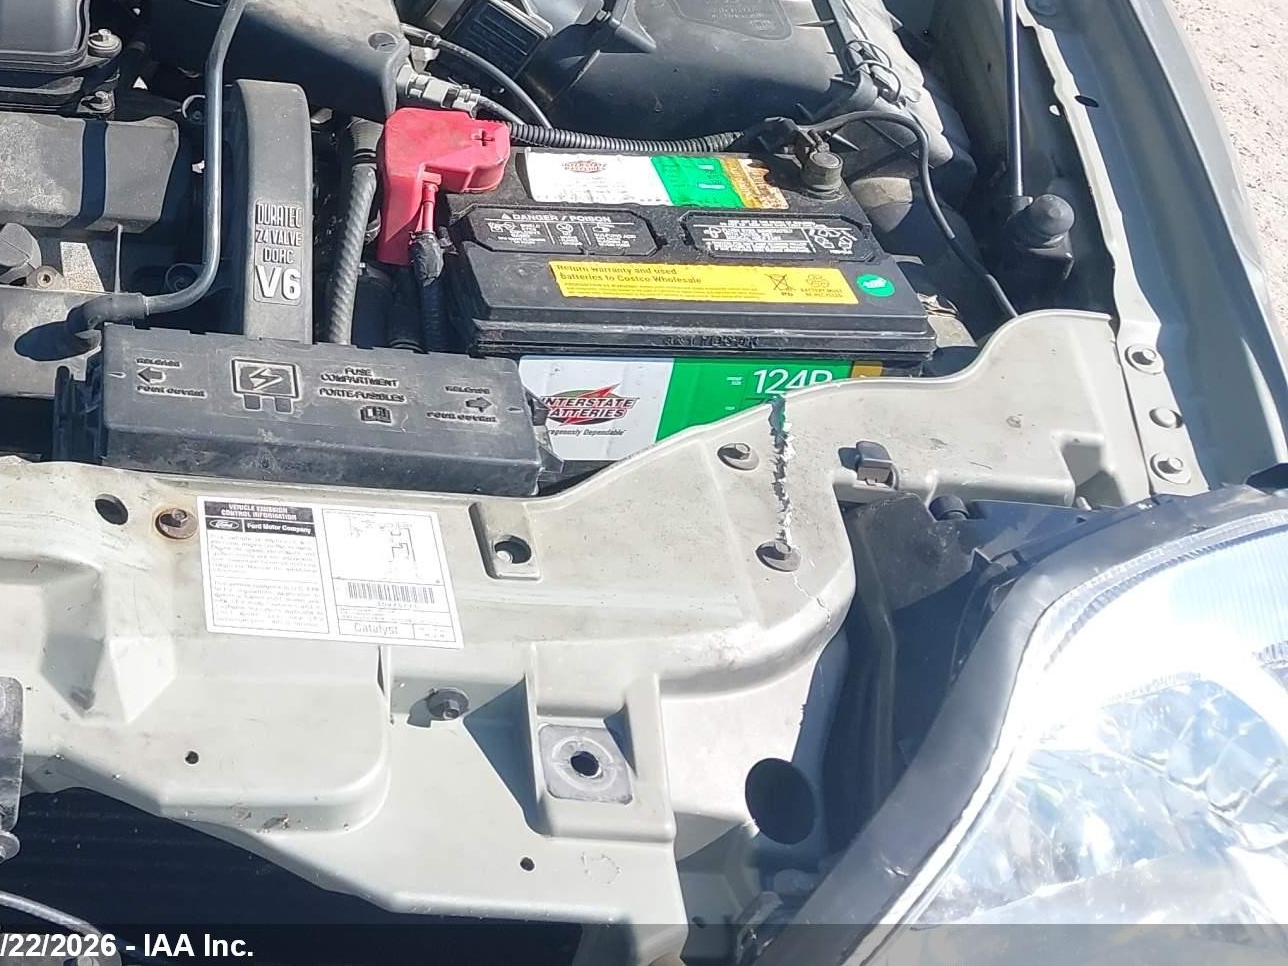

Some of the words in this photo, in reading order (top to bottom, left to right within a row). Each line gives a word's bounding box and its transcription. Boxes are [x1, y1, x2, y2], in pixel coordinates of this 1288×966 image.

[256, 203, 303, 228] DURATEC
[513, 214, 559, 222] DANGER
[255, 228, 269, 244] 24
[270, 230, 302, 247] VALVE
[263, 248, 294, 264] DOHC
[556, 264, 589, 273] Return
[591, 266, 632, 276] warranty
[634, 267, 652, 275] and
[255, 265, 302, 301] V6
[617, 274, 650, 283] Costco
[652, 275, 702, 284] Wholesale
[344, 367, 373, 377] FUSE
[321, 374, 399, 387] COMPARTMENT
[221, 509, 252, 518] CONTROL
[253, 512, 297, 521] INFORMATION
[228, 504, 255, 512] VEHICLE
[256, 506, 288, 514] EMISSION
[282, 525, 312, 534] Company
[354, 622, 399, 635] Catalyst
